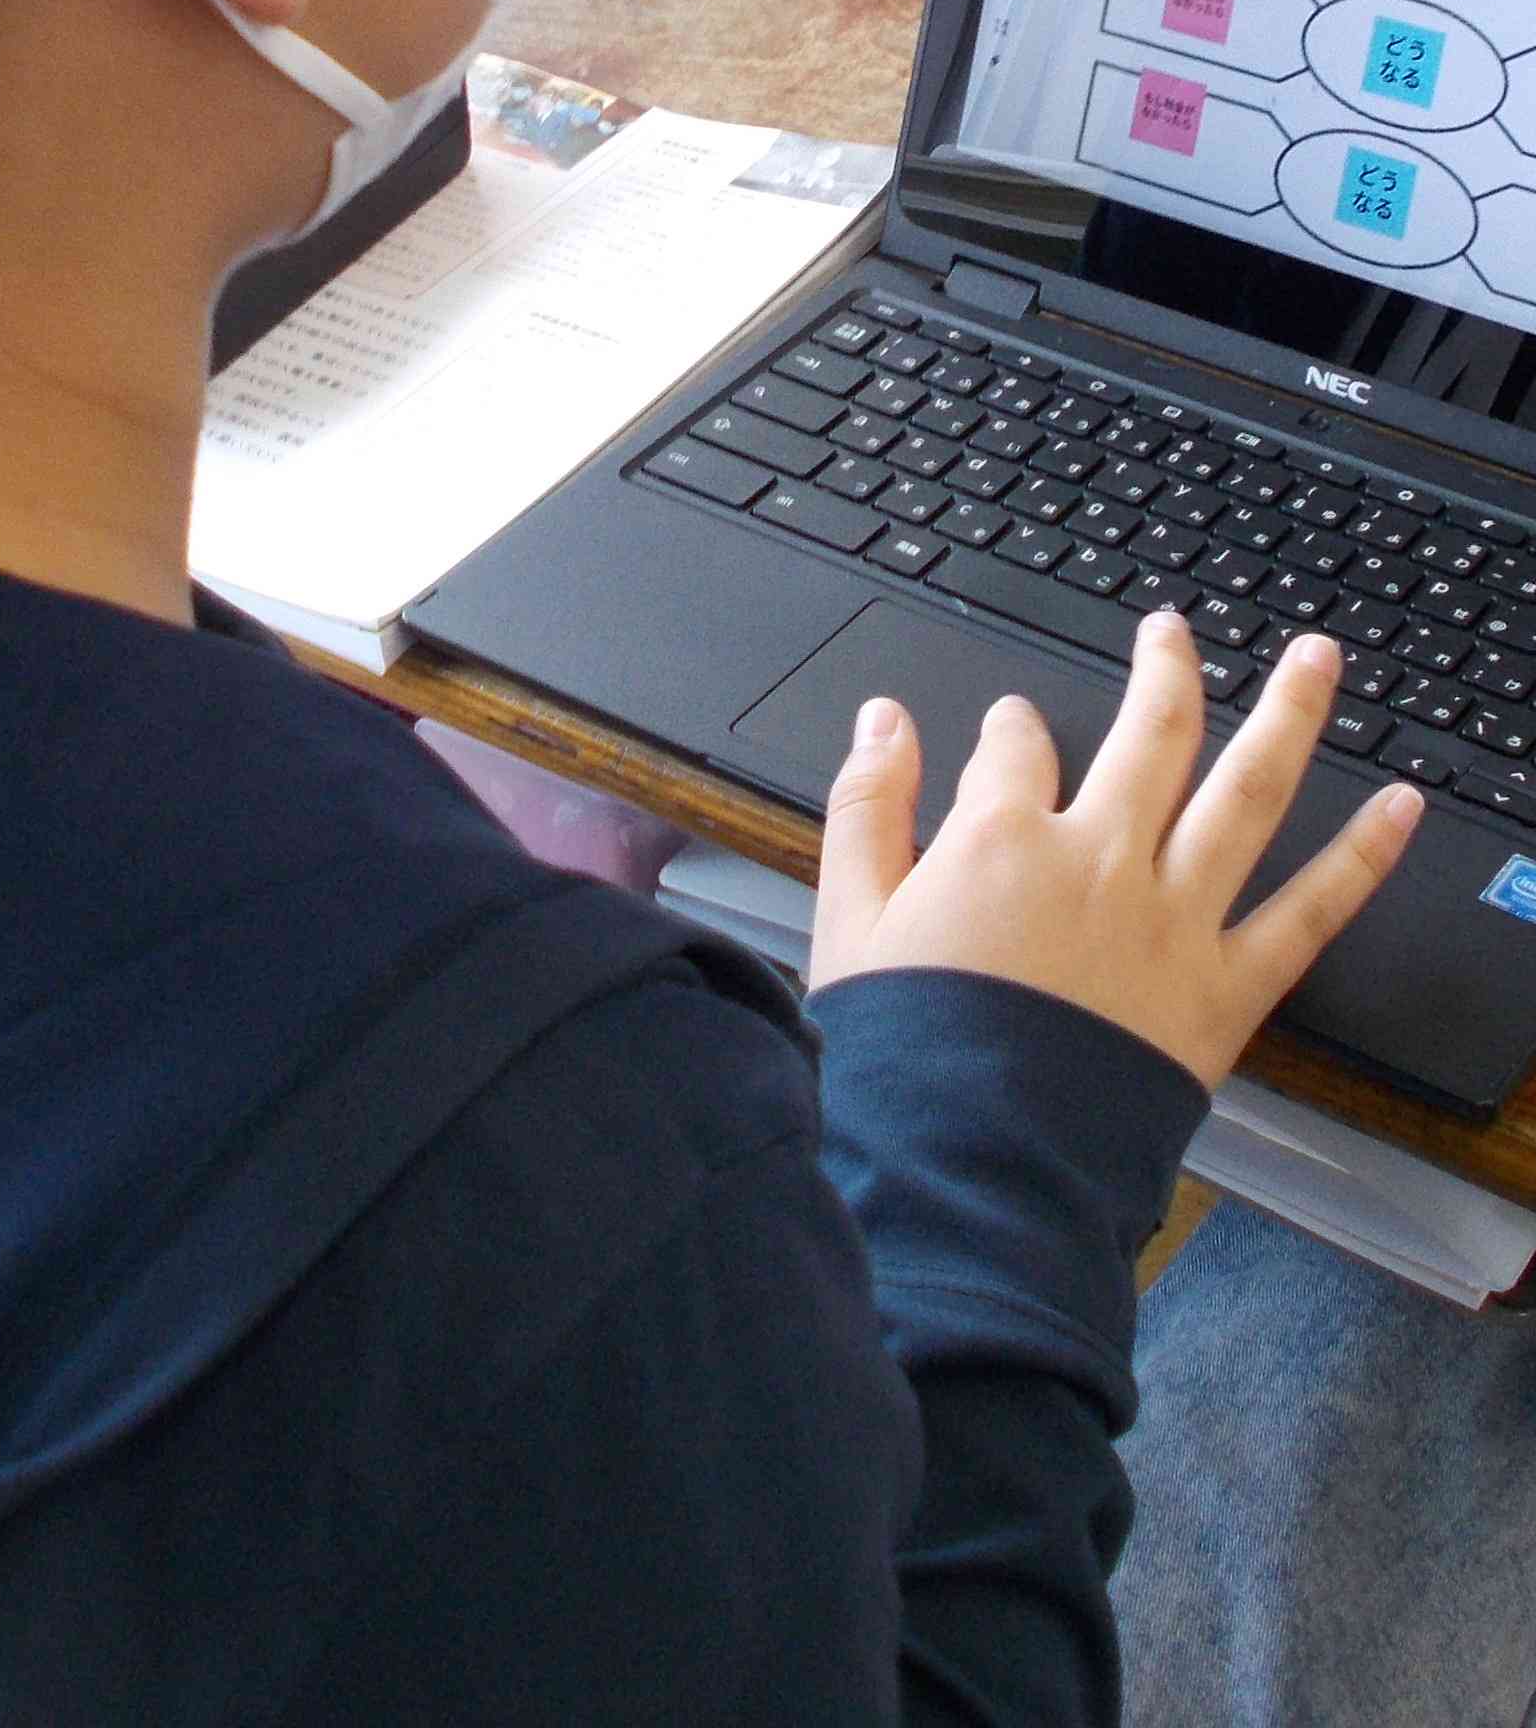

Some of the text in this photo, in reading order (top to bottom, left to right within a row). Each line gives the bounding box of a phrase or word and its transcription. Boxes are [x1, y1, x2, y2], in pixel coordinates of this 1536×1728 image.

[1386, 33, 1426, 61] どう
[1378, 60, 1421, 90] なる
[1359, 162, 1398, 192] どう
[1352, 190, 1393, 221] なる
[1305, 365, 1372, 404] NEC
[1336, 716, 1364, 732] ctrl
